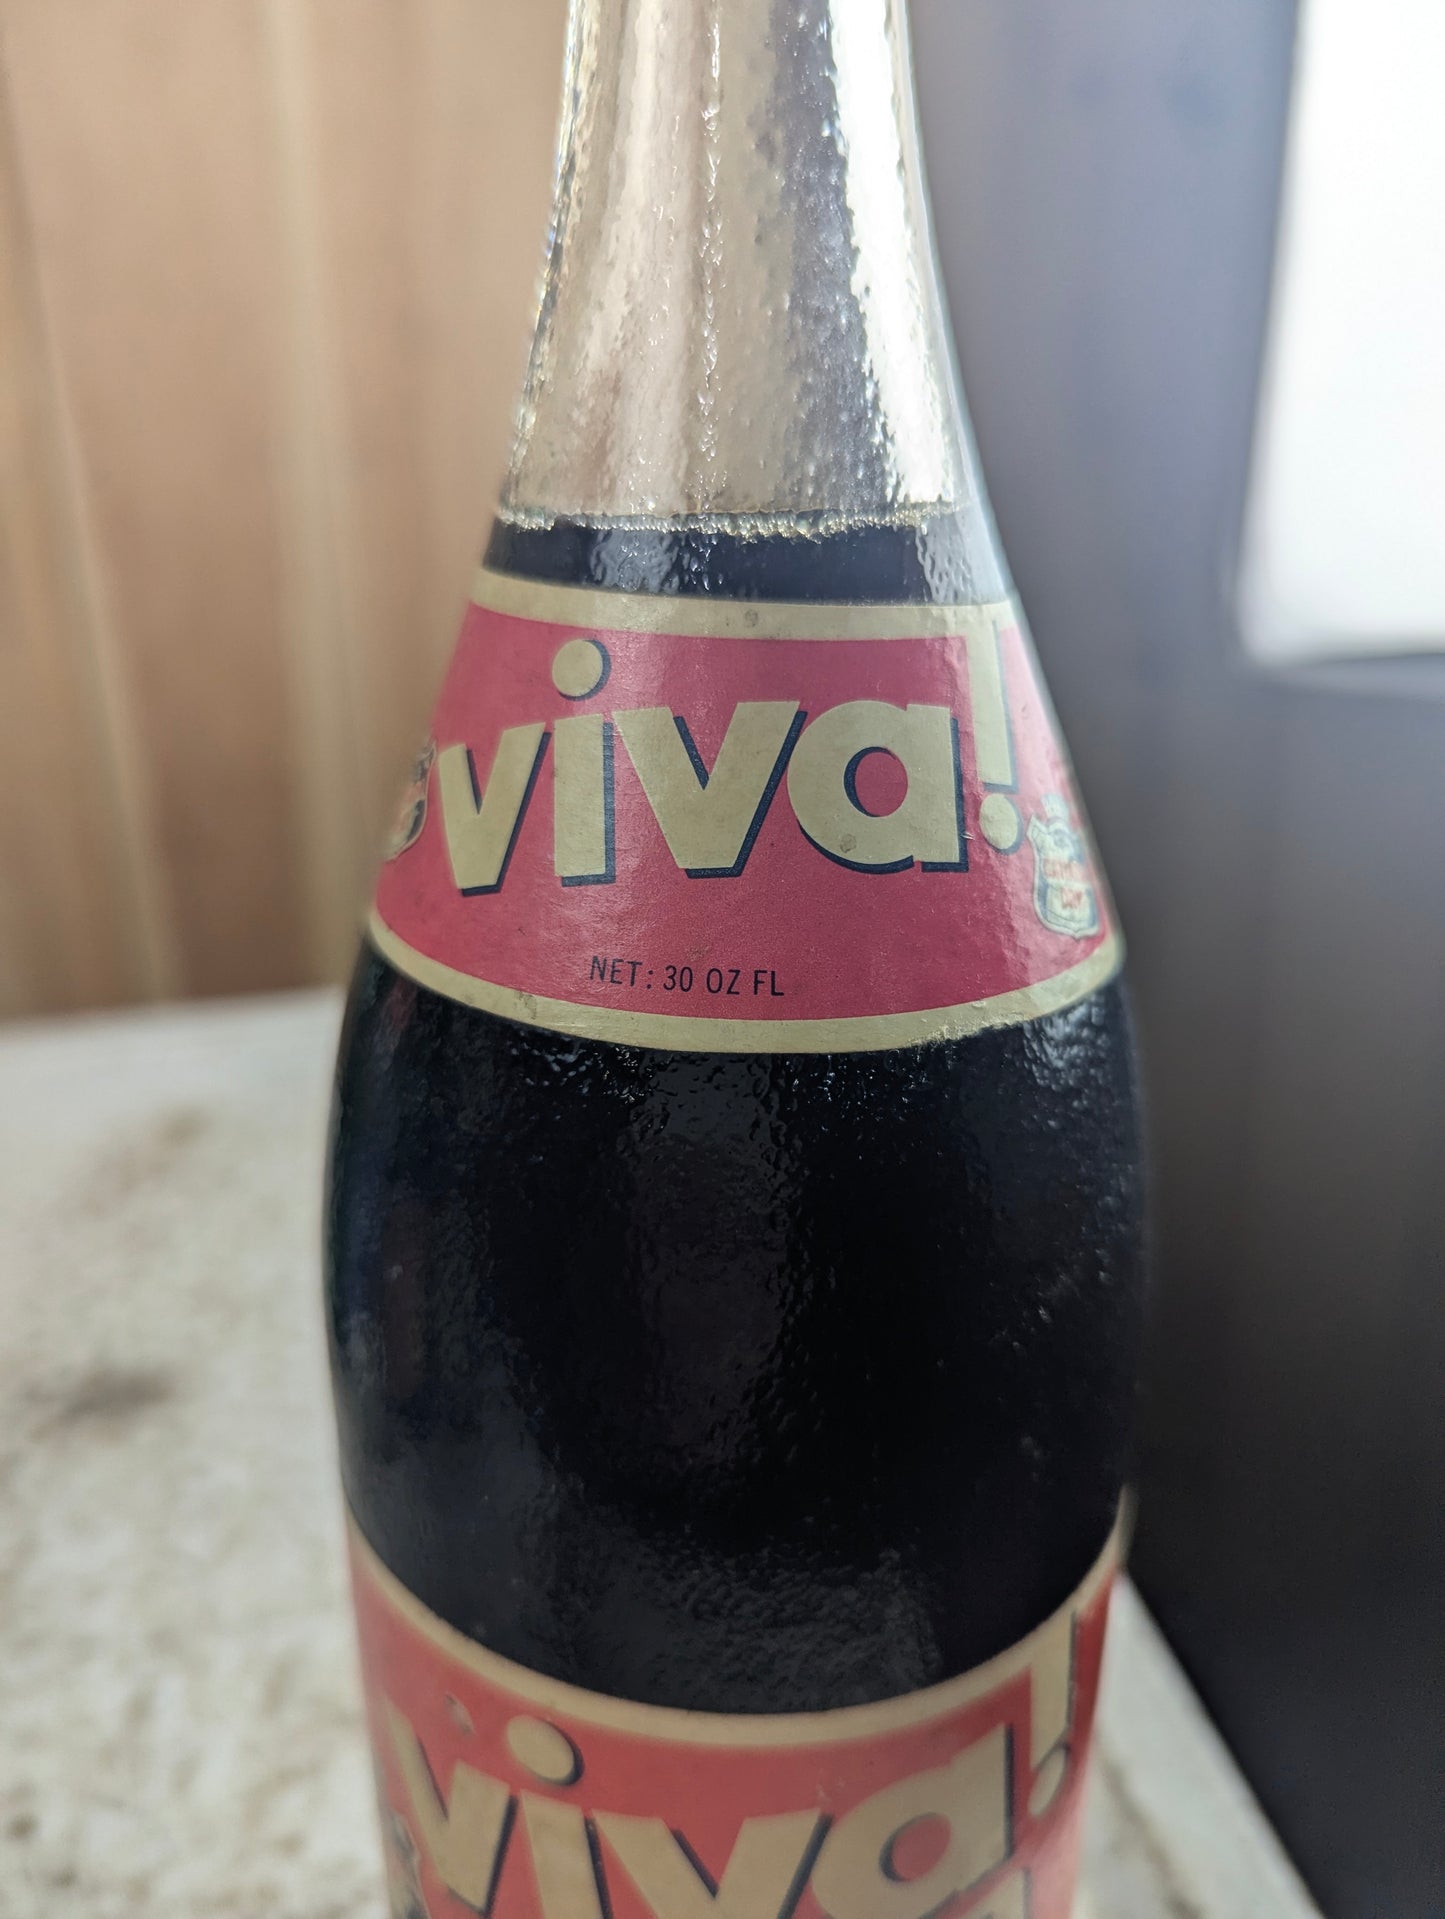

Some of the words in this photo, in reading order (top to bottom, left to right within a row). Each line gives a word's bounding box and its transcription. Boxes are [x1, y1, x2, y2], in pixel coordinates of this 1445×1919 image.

[437, 615, 1025, 897] viva!
[589, 955, 654, 988] NET:
[663, 965, 694, 993] 30
[706, 967, 742, 995] OZ
[753, 969, 785, 997] FL
